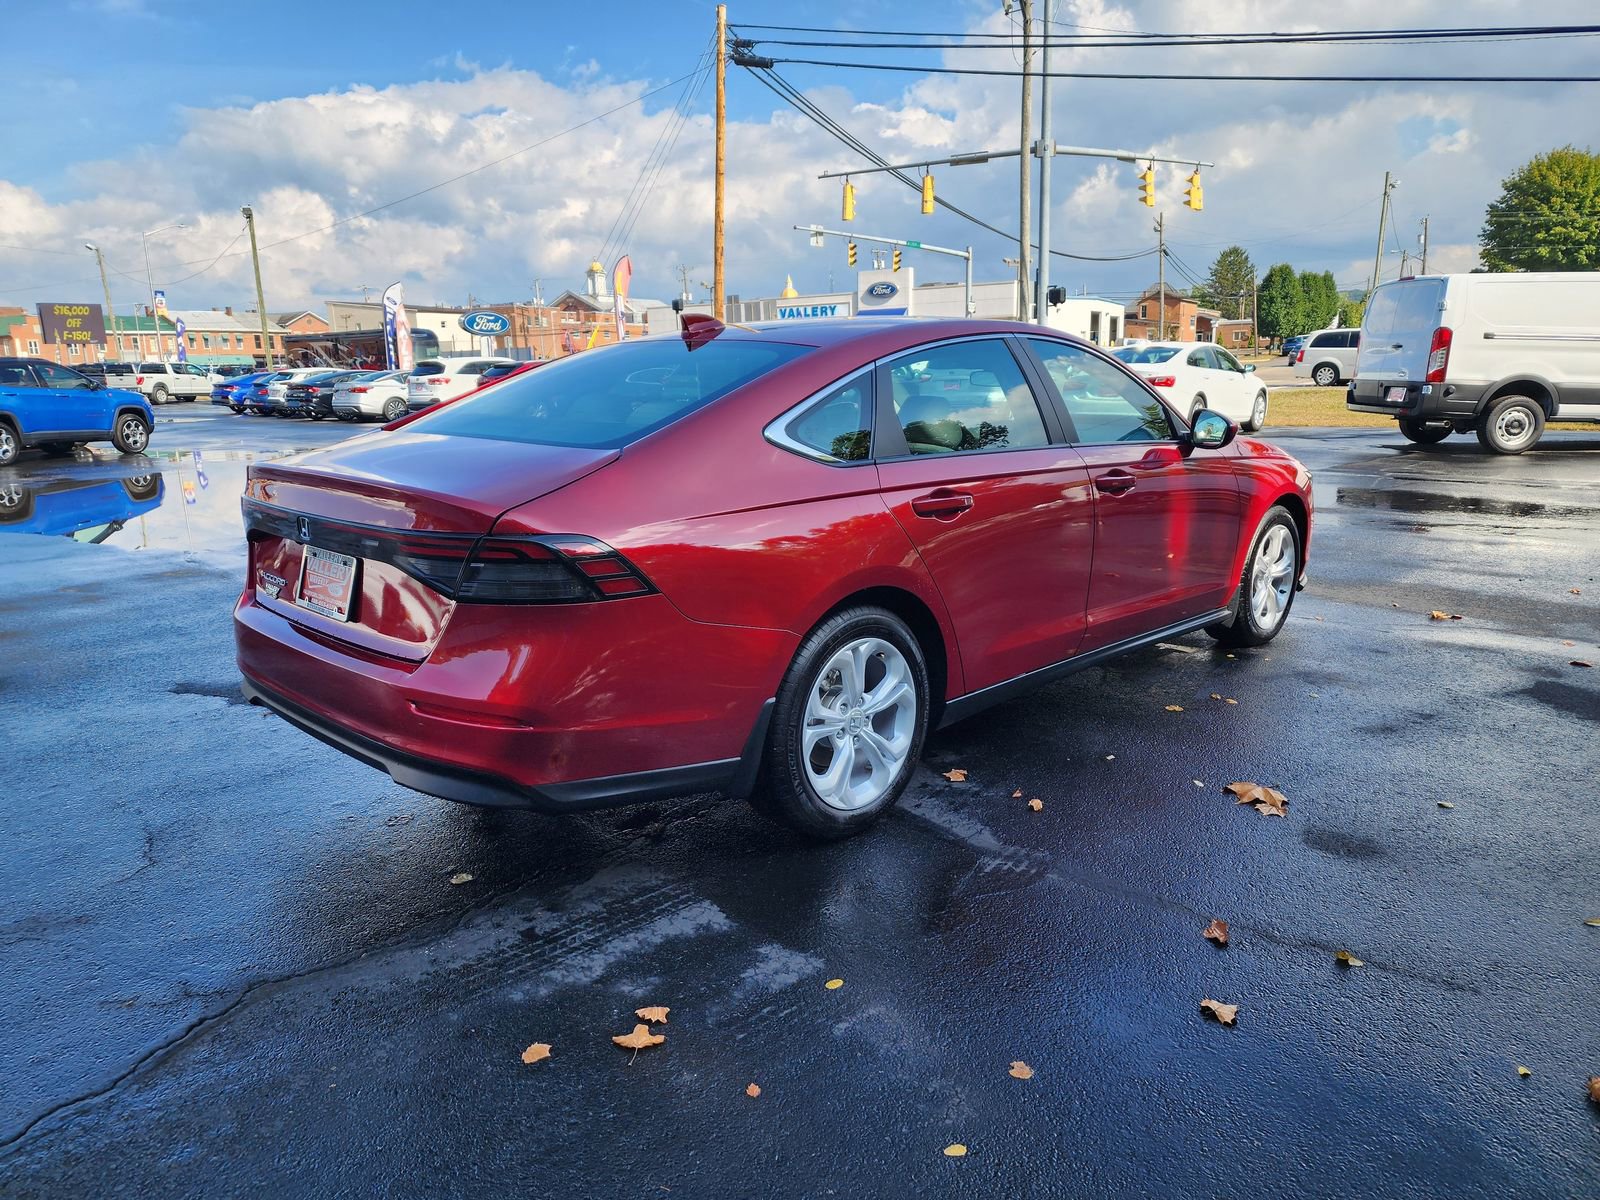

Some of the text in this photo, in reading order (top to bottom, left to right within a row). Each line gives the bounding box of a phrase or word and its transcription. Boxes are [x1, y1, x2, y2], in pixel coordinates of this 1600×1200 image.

[872, 285, 892, 295] Ford
[54, 305, 89, 316] $16,000
[780, 305, 837, 319] VALLERY
[67, 318, 82, 328] OFF
[474, 315, 502, 330] Ford
[63, 331, 91, 341] F-150!
